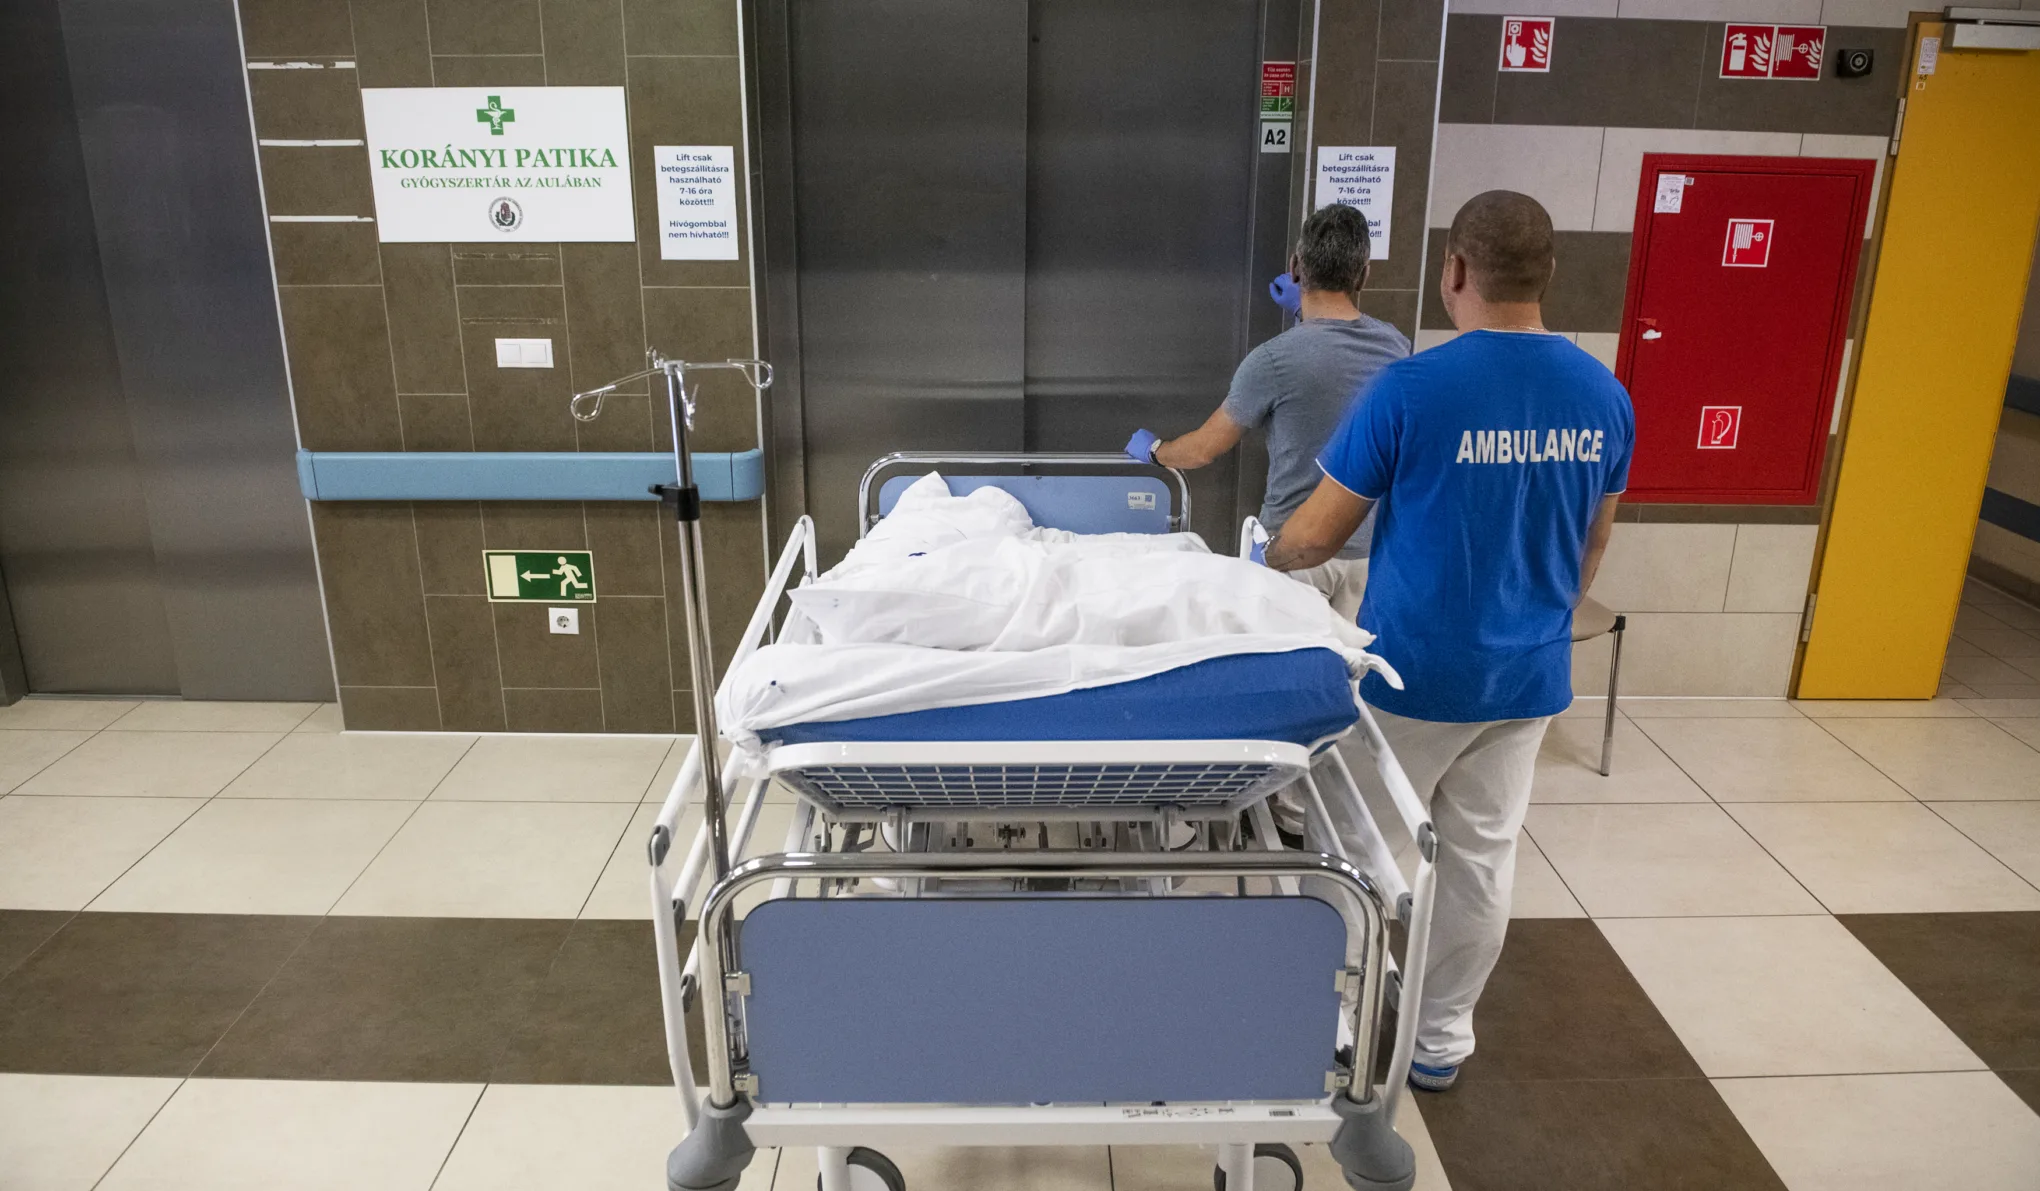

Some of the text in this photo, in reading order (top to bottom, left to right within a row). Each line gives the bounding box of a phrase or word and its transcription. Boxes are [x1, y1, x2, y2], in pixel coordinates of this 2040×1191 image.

[1264, 129, 1286, 145] A2
[380, 144, 618, 169] KORÁNYI PATIKA
[661, 165, 729, 174] betegszállításra
[1322, 164, 1389, 173] betegszállításra
[400, 175, 602, 189] GYÓGYSZERTÁR AZ AULÁBAN
[669, 176, 722, 184] használható
[669, 220, 727, 228] Hívógombbal
[1455, 428, 1604, 464] AMBULANCE
